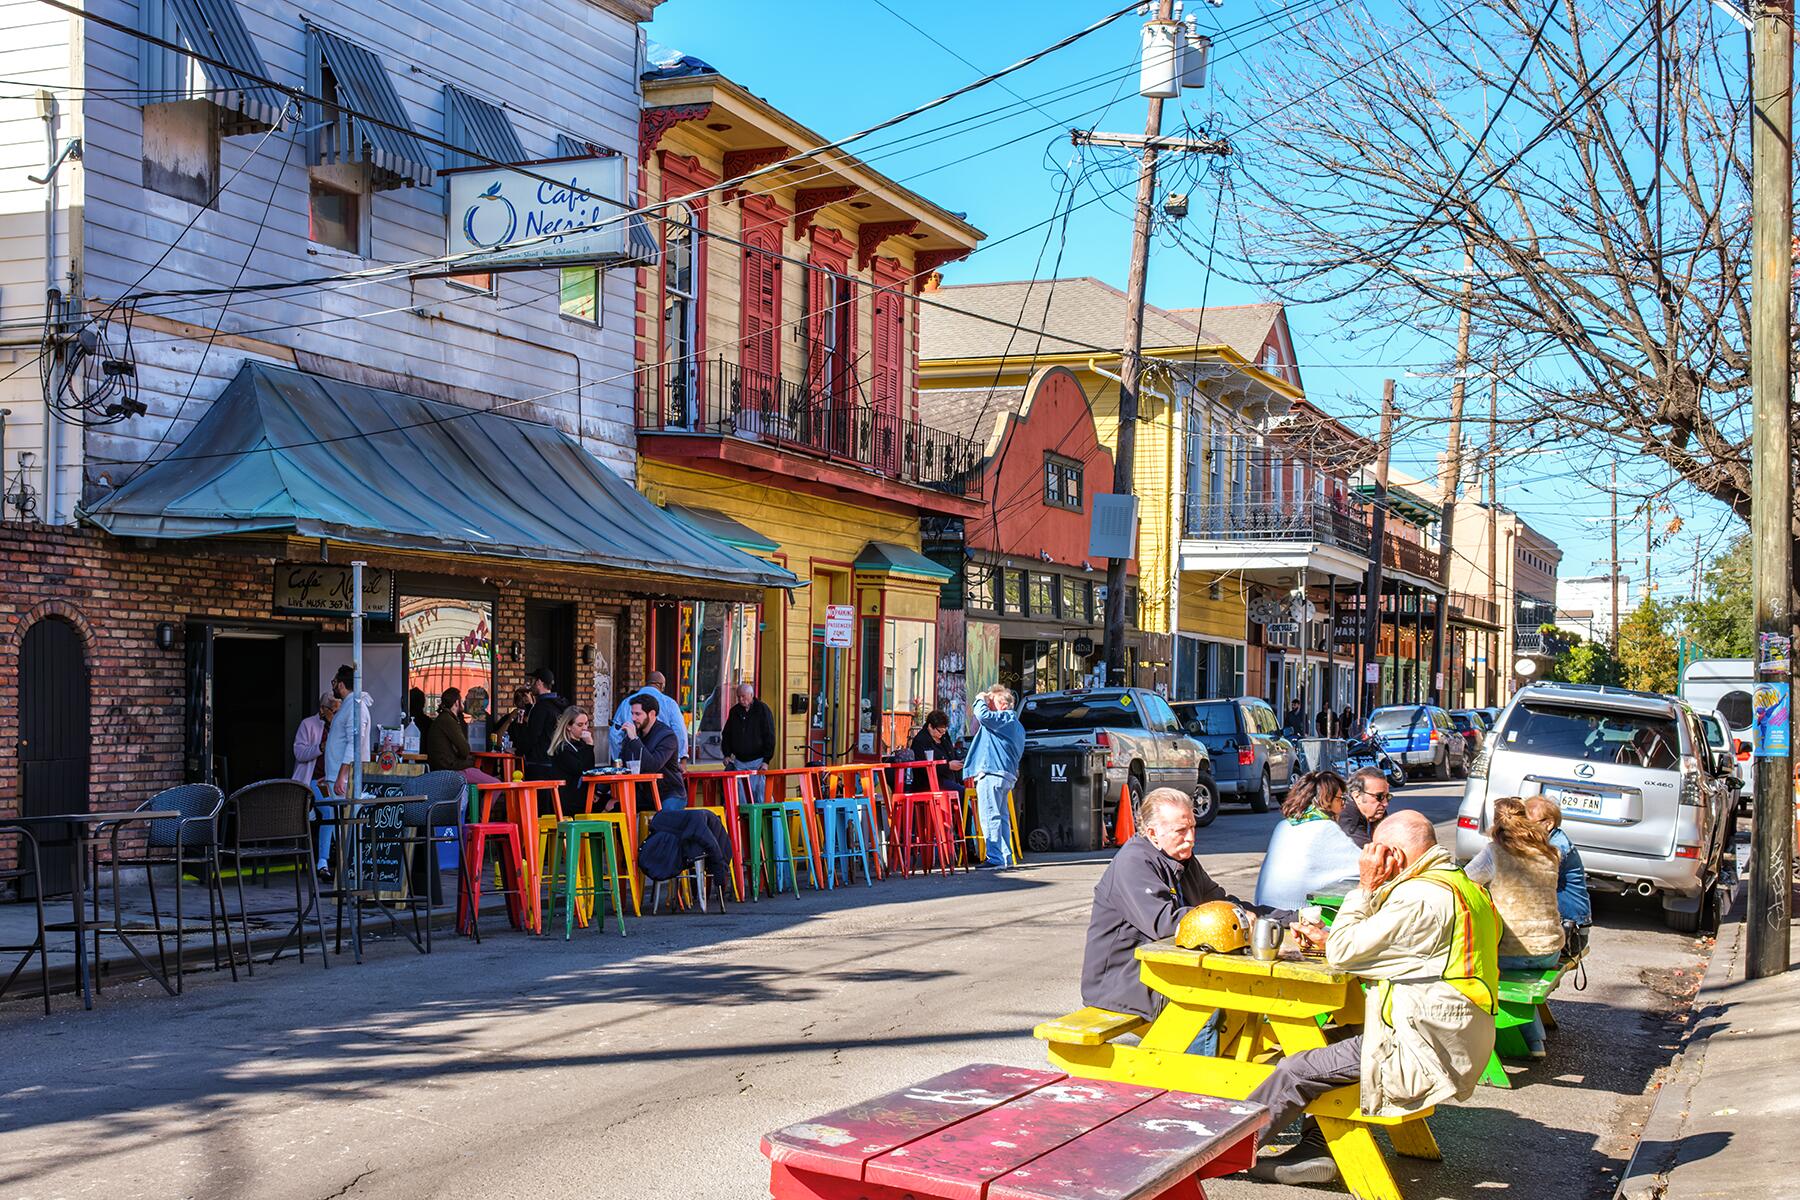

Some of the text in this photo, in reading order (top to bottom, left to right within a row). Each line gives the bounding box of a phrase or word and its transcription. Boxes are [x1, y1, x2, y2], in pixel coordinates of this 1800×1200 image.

[1051, 763, 1067, 777] IV
[1561, 796, 1600, 809] 629 FAN
